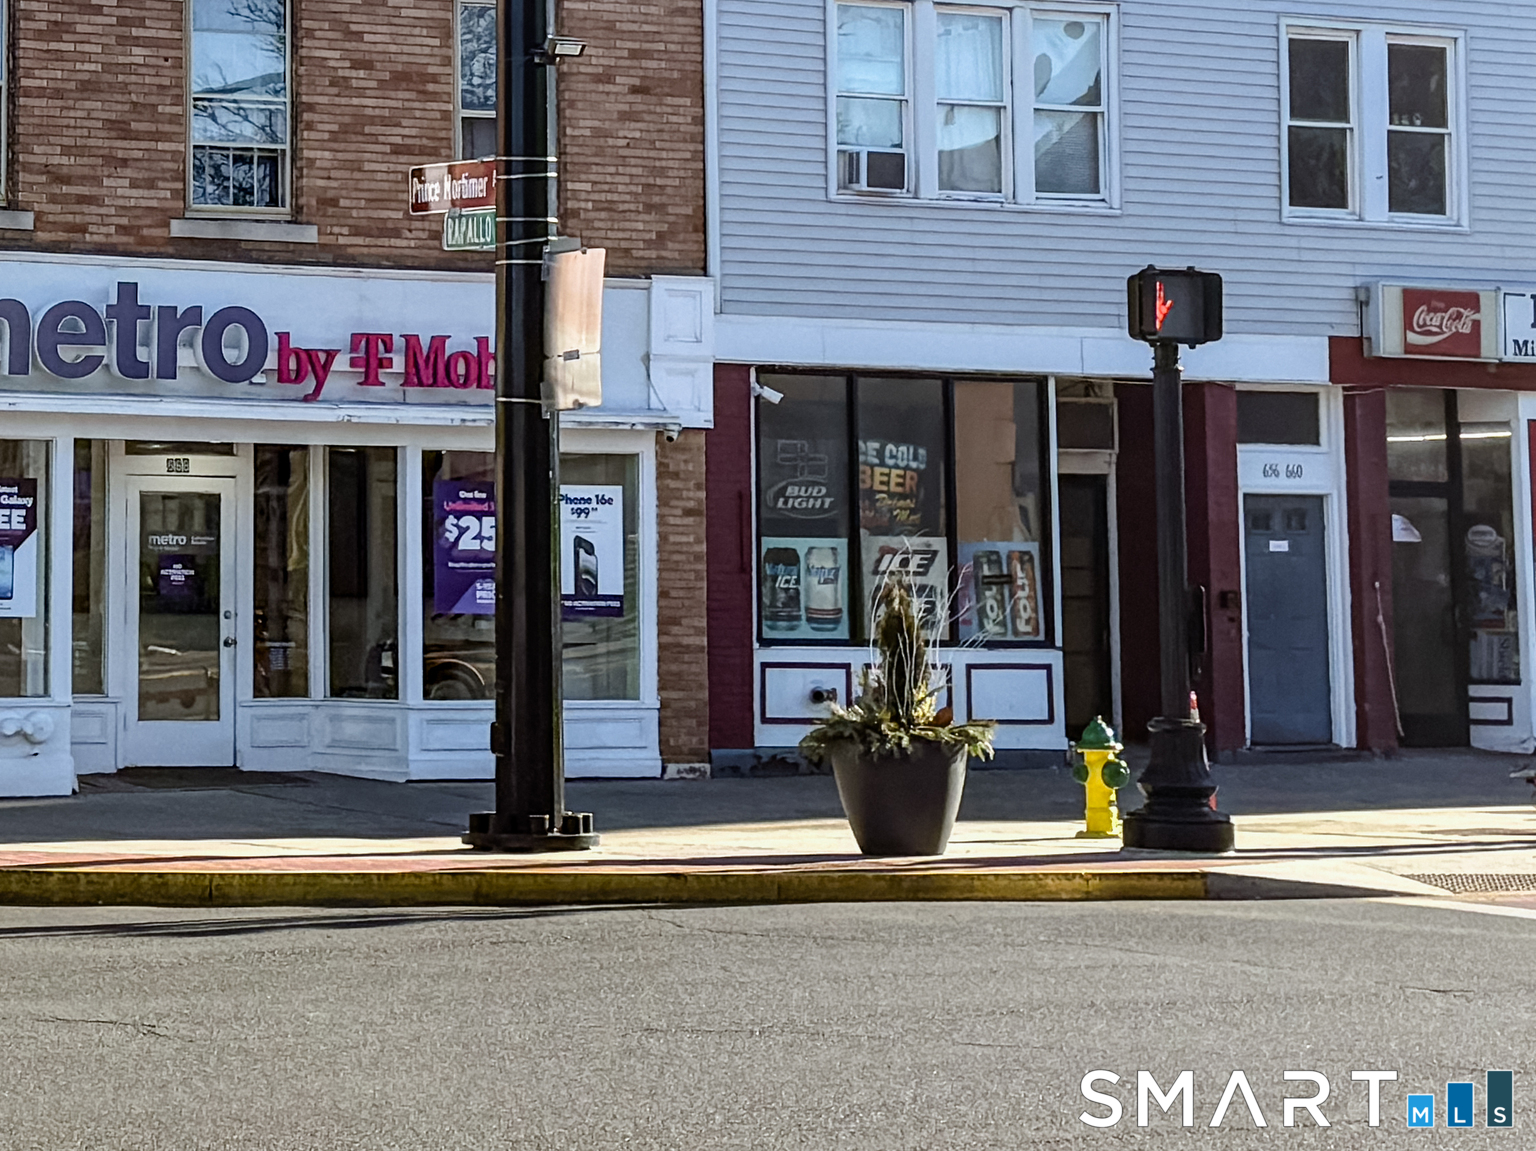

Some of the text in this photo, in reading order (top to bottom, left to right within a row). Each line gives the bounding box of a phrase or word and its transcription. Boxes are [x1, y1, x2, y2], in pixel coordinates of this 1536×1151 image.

[412, 177, 441, 204] Prince
[444, 171, 488, 200] Mortimer
[447, 215, 492, 245] RAPALLO
[274, 332, 341, 401] by
[884, 443, 927, 470] COLD
[859, 464, 918, 494] BEER
[559, 494, 614, 506] Phone 16e
[785, 485, 827, 497] BUD
[0, 494, 34, 508] Galaxy
[776, 497, 835, 509] LIGHT
[148, 534, 187, 546] metro
[444, 514, 495, 552] $25
[878, 553, 932, 572] ICE
[775, 575, 800, 588] ICE
